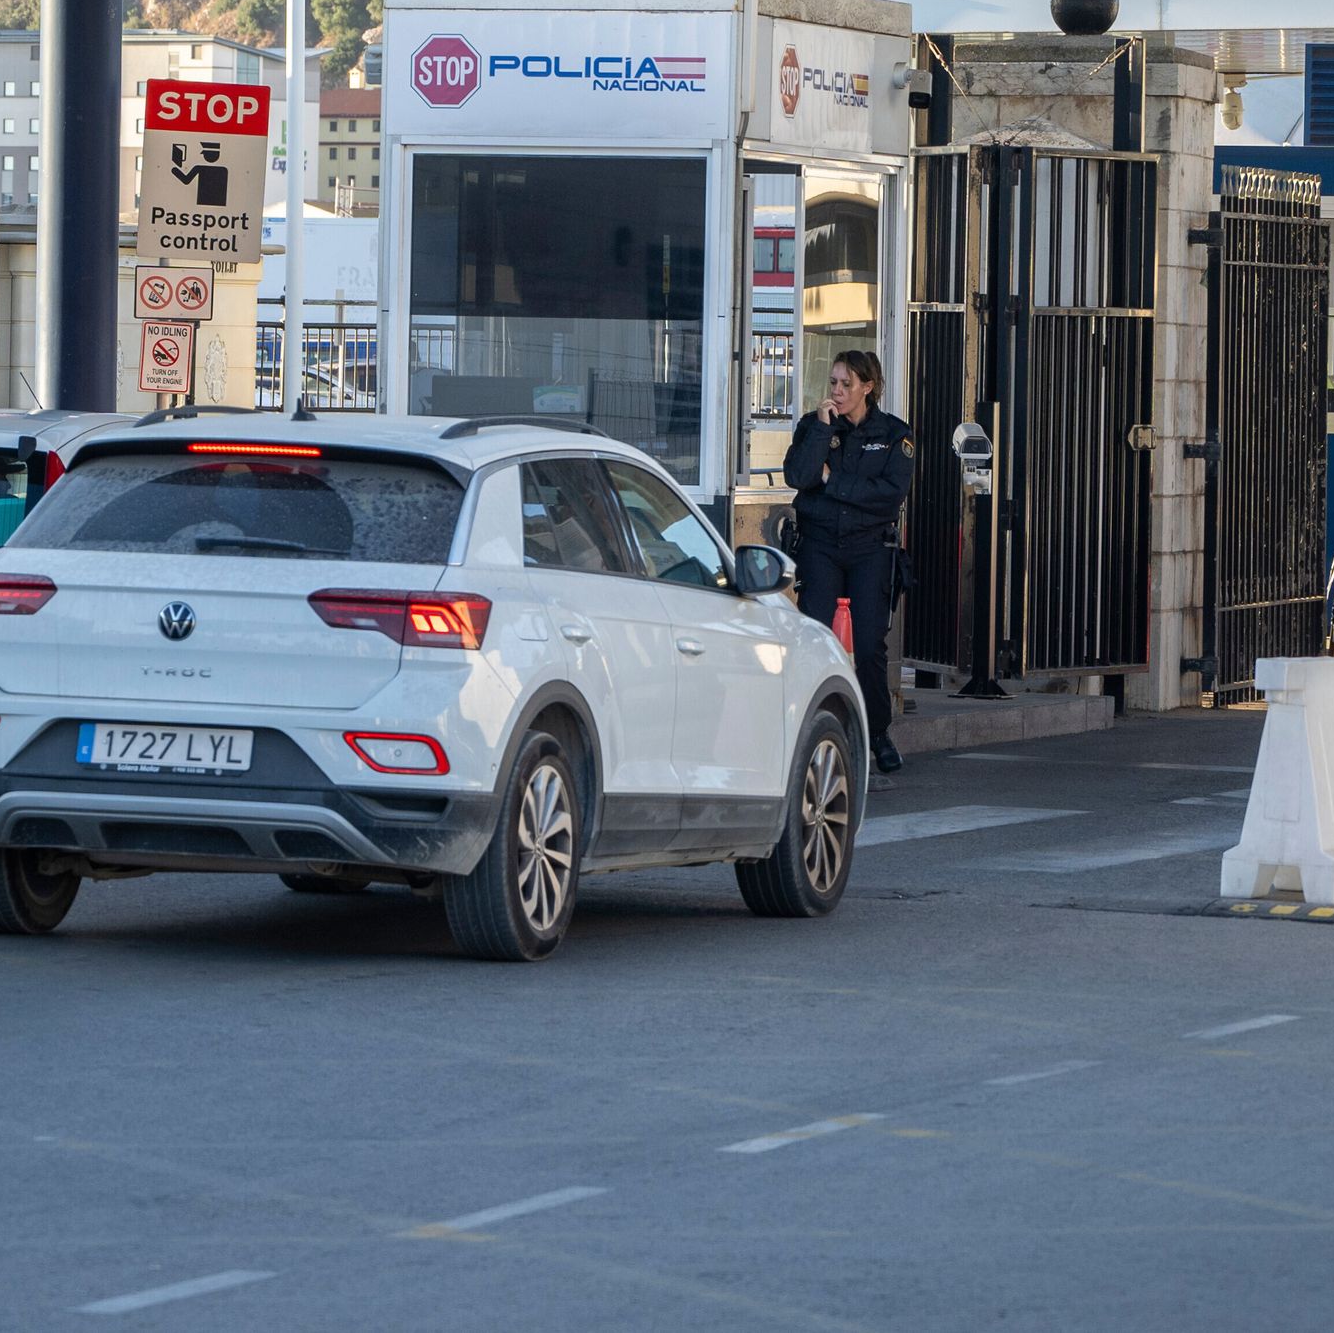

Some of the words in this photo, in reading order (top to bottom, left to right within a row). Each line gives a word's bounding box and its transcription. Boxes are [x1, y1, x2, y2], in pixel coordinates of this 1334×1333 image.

[418, 56, 474, 86] STOP
[593, 79, 706, 92] NACIONAL
[781, 66, 799, 97] STOP
[157, 91, 259, 125] STOP
[834, 94, 869, 109] NACIONAL
[151, 206, 249, 231] Passport
[160, 232, 239, 253] control
[147, 326, 160, 336] NO
[161, 326, 188, 338] IDLING
[146, 376, 162, 384] YOUR
[163, 377, 183, 385] ENGINE
[152, 368, 166, 376] TURN
[167, 369, 178, 377] OFF
[140, 666, 212, 678] T-ROC
[105, 730, 177, 760] 1727
[186, 733, 242, 764] LYL
